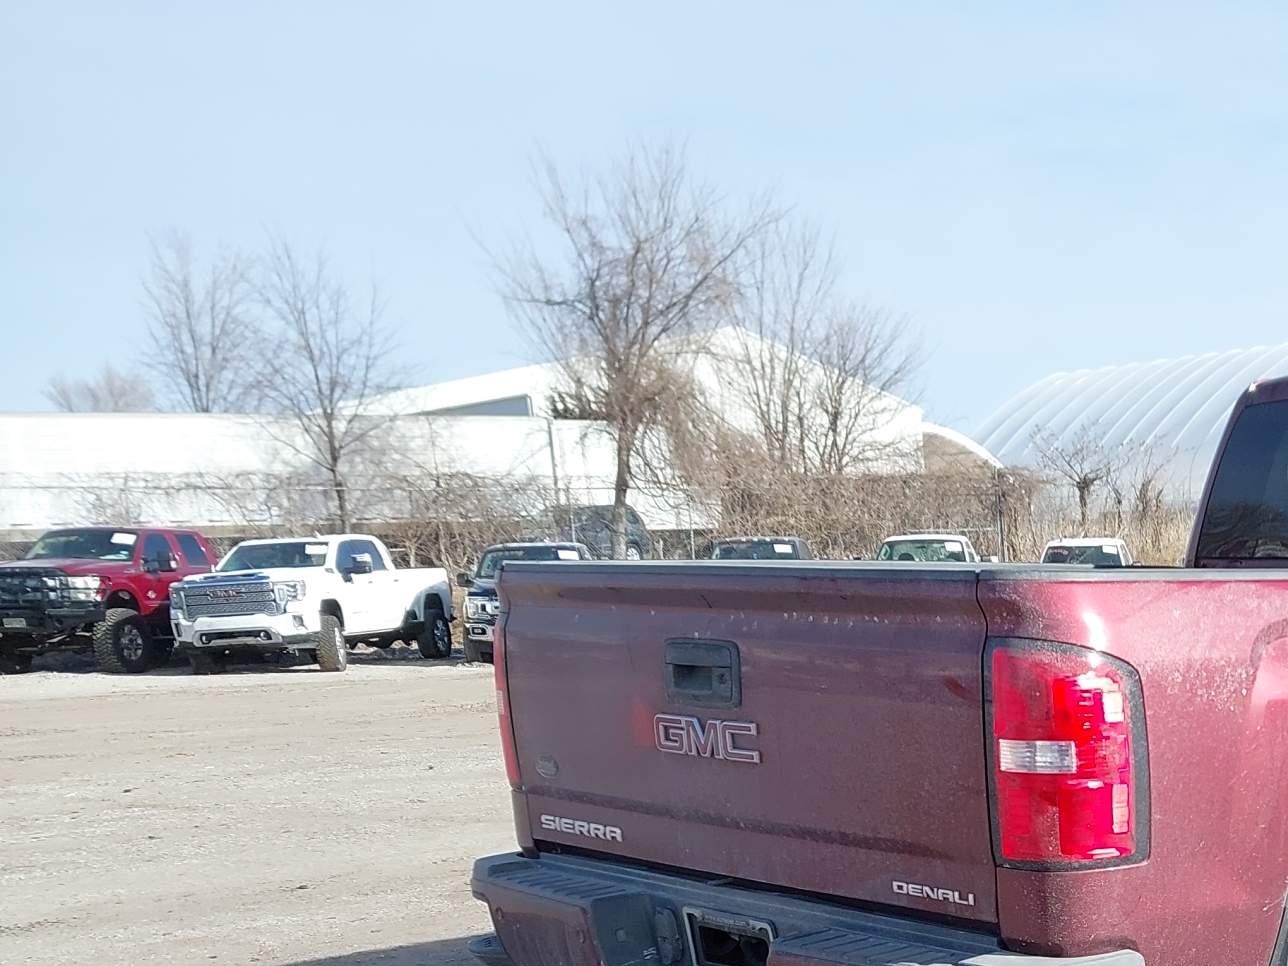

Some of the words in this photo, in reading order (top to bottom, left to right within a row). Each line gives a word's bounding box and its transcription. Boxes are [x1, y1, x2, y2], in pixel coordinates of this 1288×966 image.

[654, 714, 760, 763] GMC
[541, 814, 622, 842] SIERRA
[892, 881, 975, 906] DENALI
